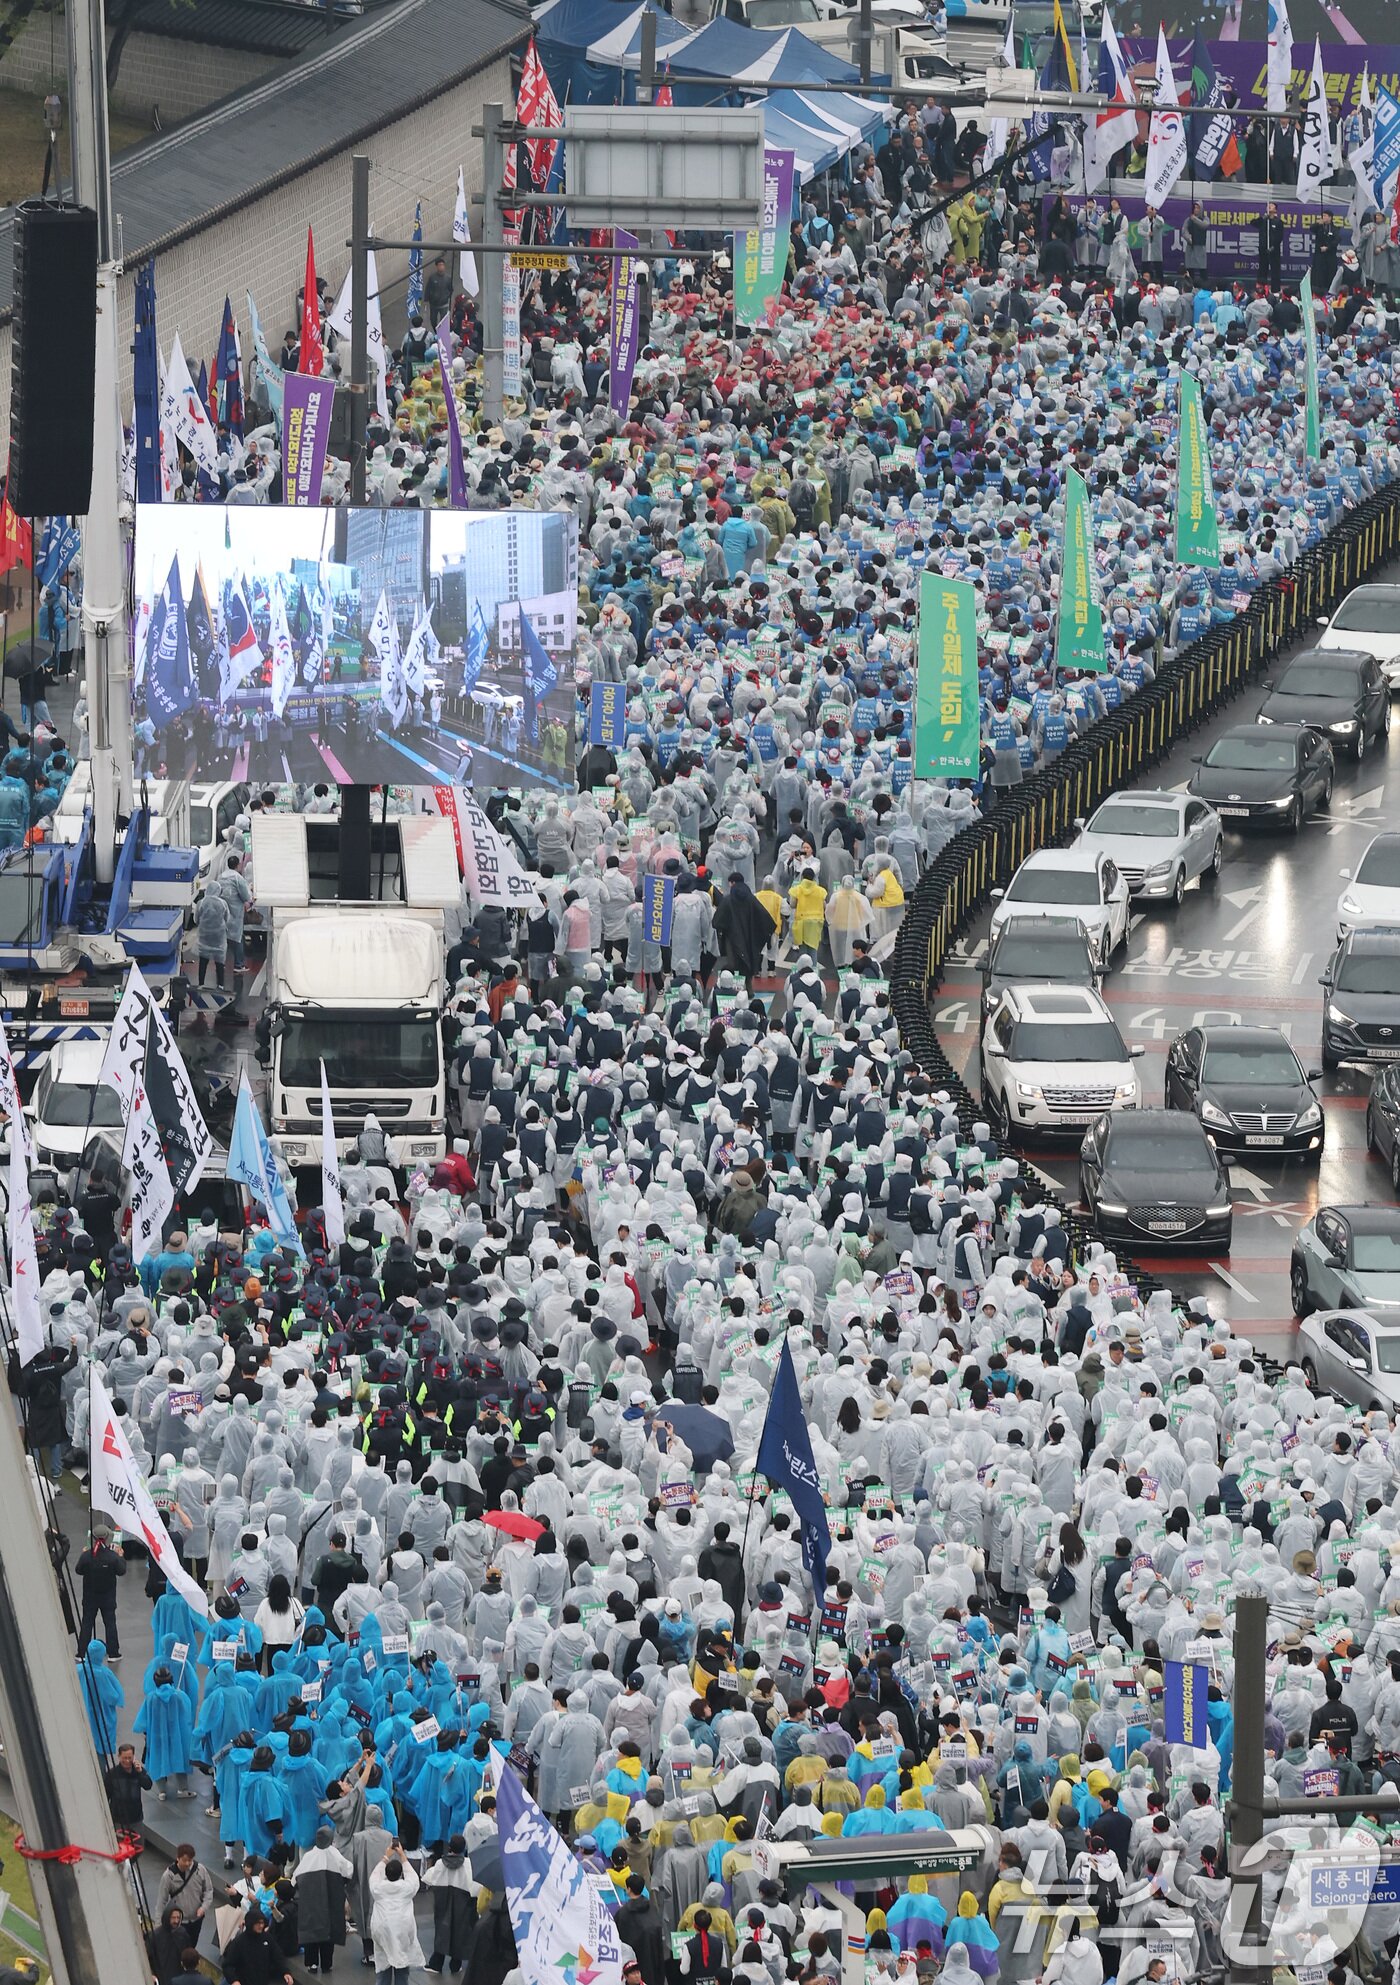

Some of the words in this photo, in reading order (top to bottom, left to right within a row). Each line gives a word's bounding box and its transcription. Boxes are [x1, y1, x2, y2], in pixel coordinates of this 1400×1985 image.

[763, 173, 779, 229] 노동자의
[941, 592, 963, 676] 주4일제
[601, 686, 616, 743] 공공노련
[940, 682, 962, 725] 도입
[939, 756, 972, 767] 한국노총
[652, 878, 666, 942] 공공연맹
[1121, 947, 1293, 981] 삼청동
[958, 1856, 973, 1871] 종로
[1314, 1868, 1390, 1889] 세종대로
[1314, 1889, 1398, 1905] Sejong-daero
